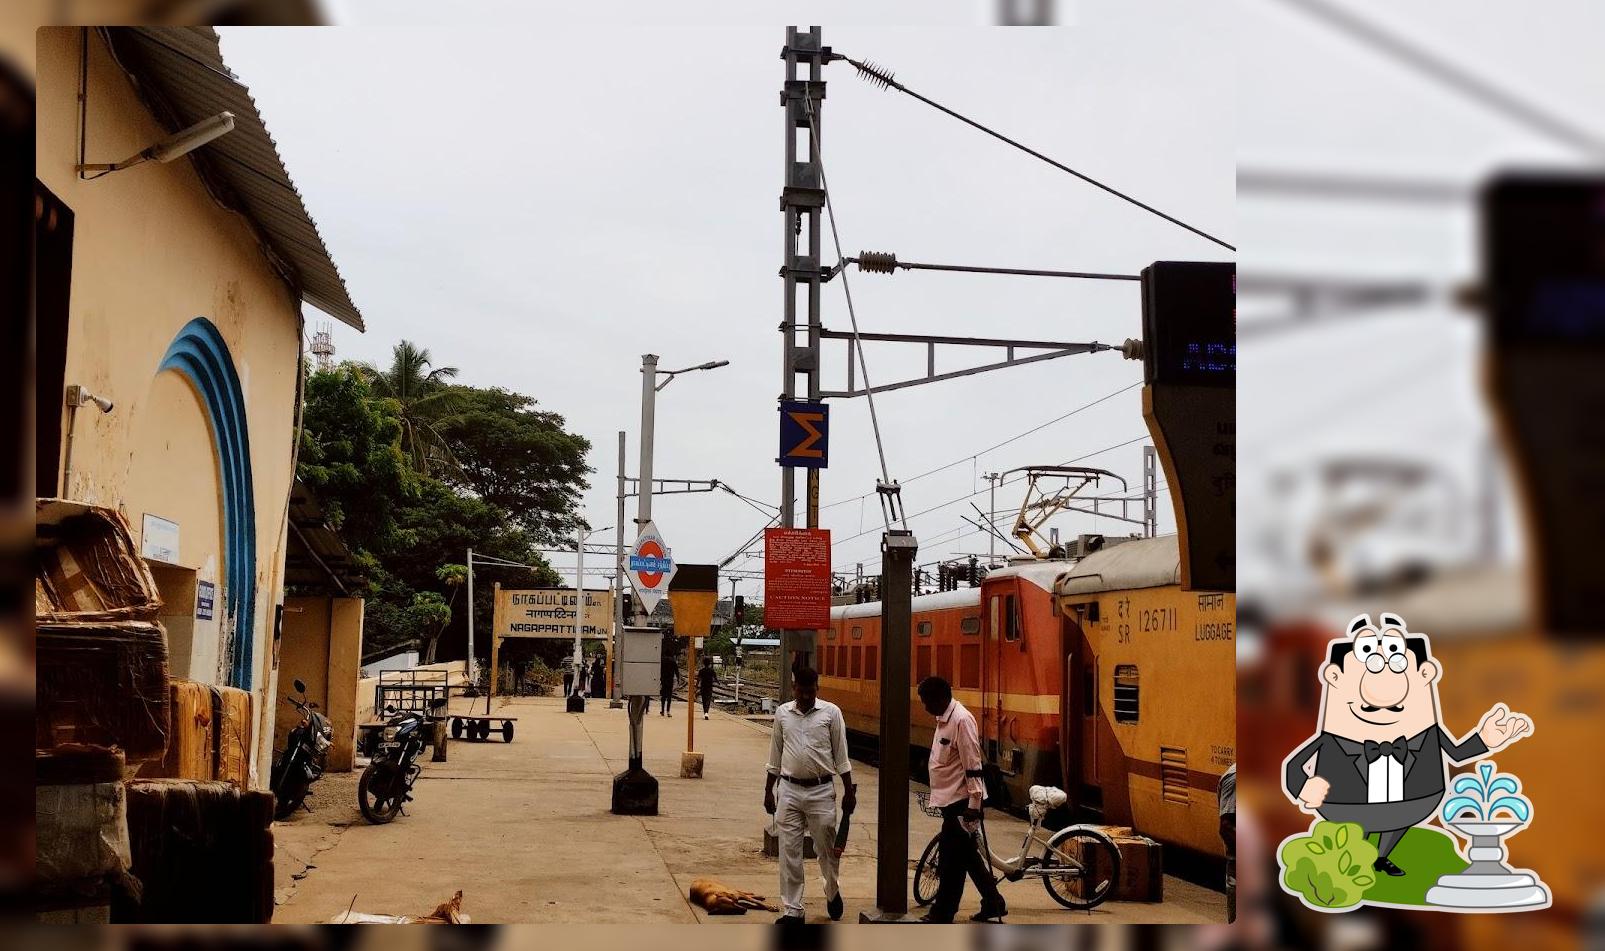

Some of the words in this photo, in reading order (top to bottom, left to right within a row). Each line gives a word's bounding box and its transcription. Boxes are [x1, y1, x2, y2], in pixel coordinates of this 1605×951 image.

[510, 623, 596, 634] NAGAPPATTIAM
[1138, 608, 1177, 633] 126711
[1118, 624, 1131, 644] SR
[1195, 623, 1232, 641] LUGGAGE
